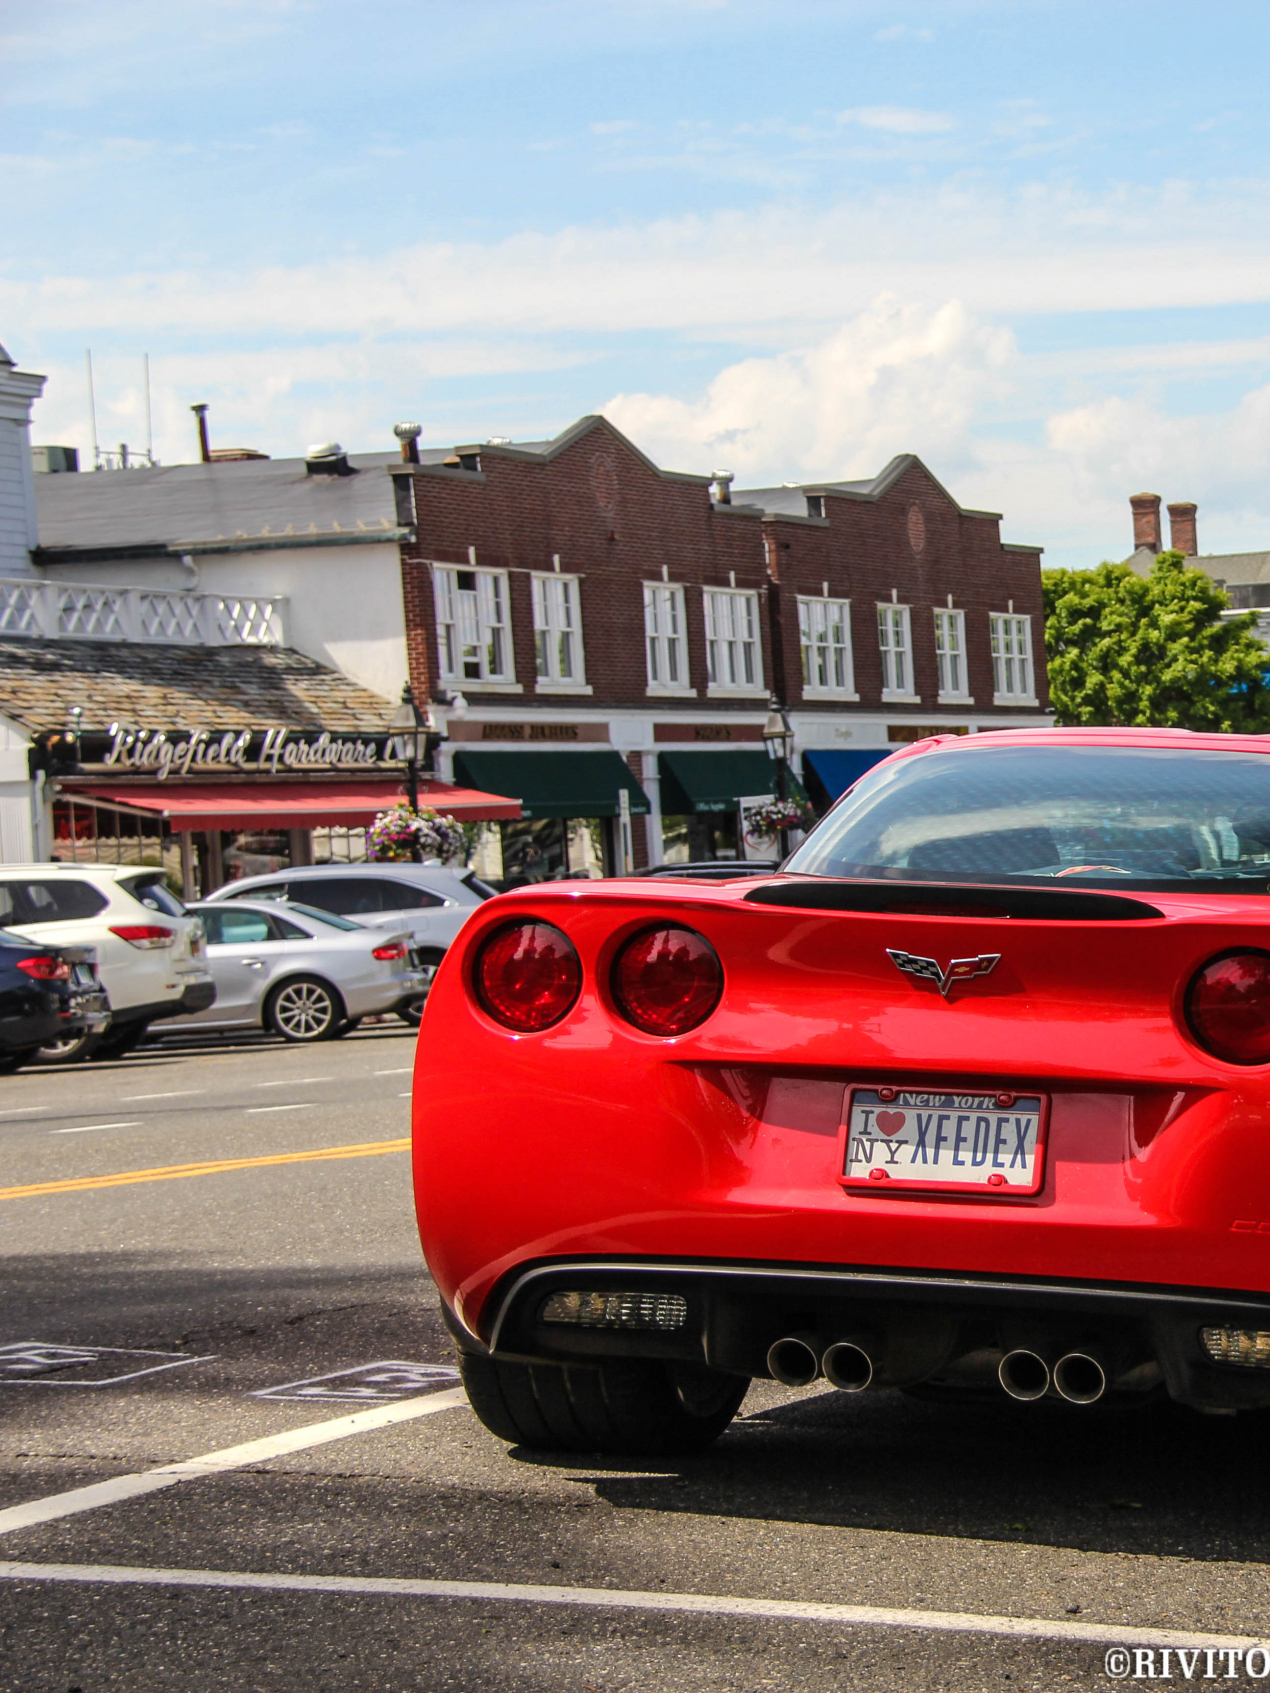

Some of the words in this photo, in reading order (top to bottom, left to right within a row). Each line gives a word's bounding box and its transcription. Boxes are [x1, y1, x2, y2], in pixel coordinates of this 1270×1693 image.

[105, 722, 252, 780] Ridgefield
[258, 727, 376, 773] Hardware
[899, 1092, 945, 1107] New
[953, 1095, 996, 1109] York
[858, 1109, 875, 1136] I
[849, 1137, 909, 1165] NY
[910, 1112, 1032, 1169] XFEDEX
